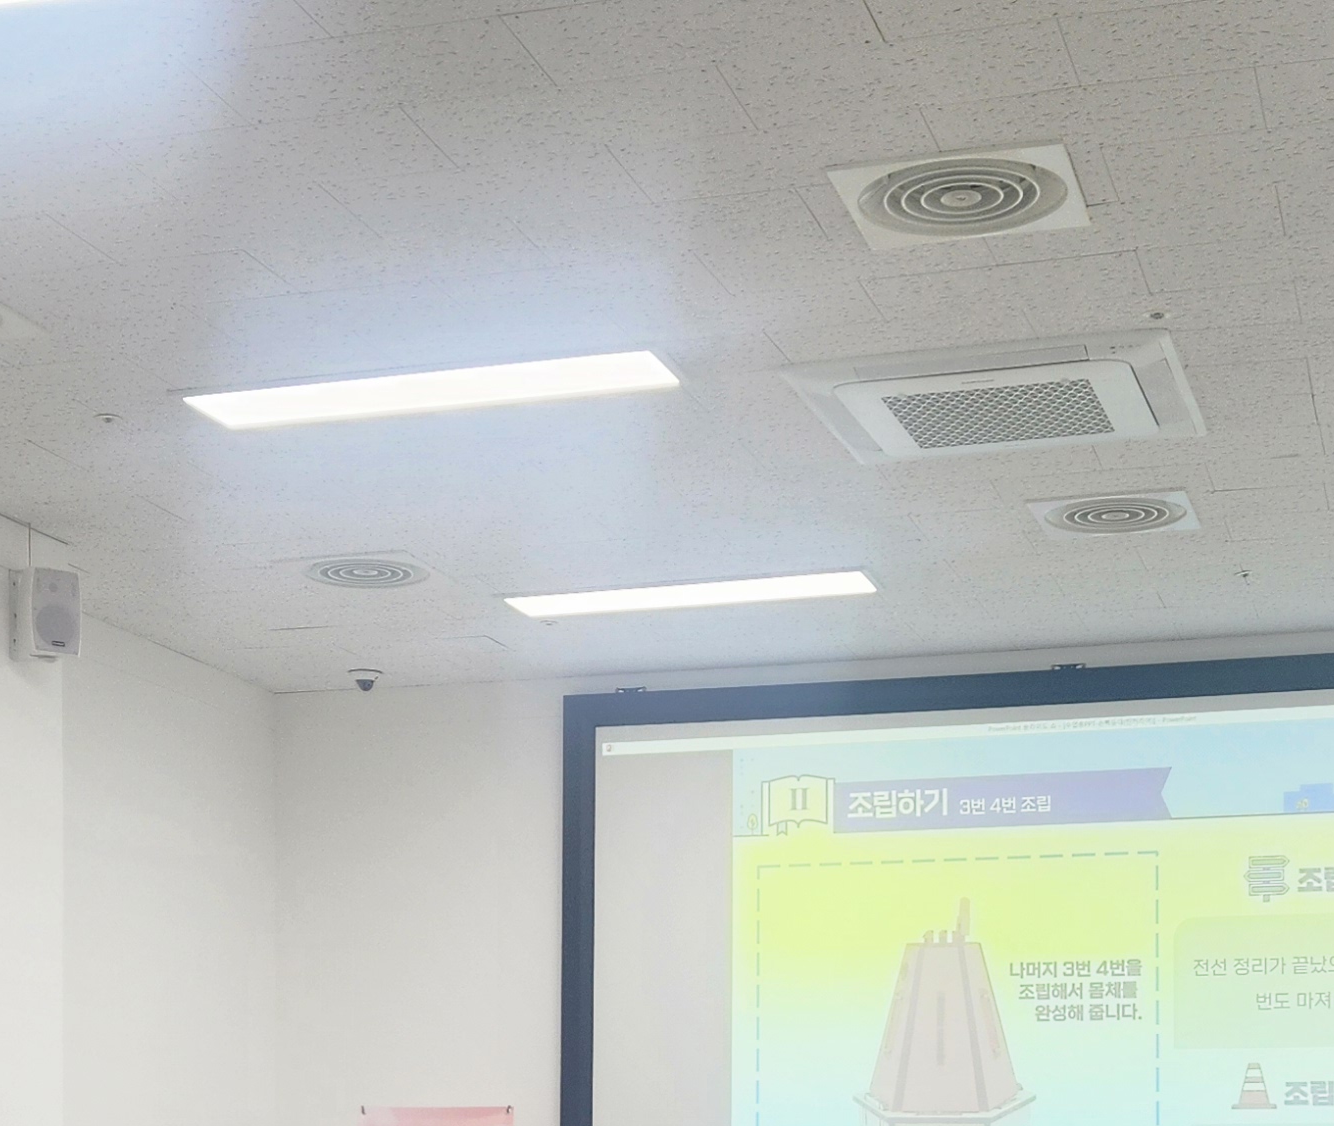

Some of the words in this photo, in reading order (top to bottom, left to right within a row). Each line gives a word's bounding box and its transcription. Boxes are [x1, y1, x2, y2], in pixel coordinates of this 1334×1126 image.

[847, 788, 948, 819] 조립하기
[959, 798, 986, 816] 3번
[990, 796, 1017, 814] 4번
[1021, 795, 1052, 813] 조립
[1009, 961, 1058, 979] 나머지
[1062, 960, 1092, 977] 3번
[1096, 958, 1143, 976] 4번을
[1192, 958, 1227, 977] 전선
[1233, 956, 1286, 976] 정리가
[1018, 982, 1084, 1000] 조립해서
[1088, 980, 1138, 999] 몸체를
[1255, 991, 1291, 1011] 번도
[1296, 991, 1332, 1010] 마져
[1035, 1004, 1084, 1022] 완성해
[1088, 1003, 1143, 1021] 줍니다.
